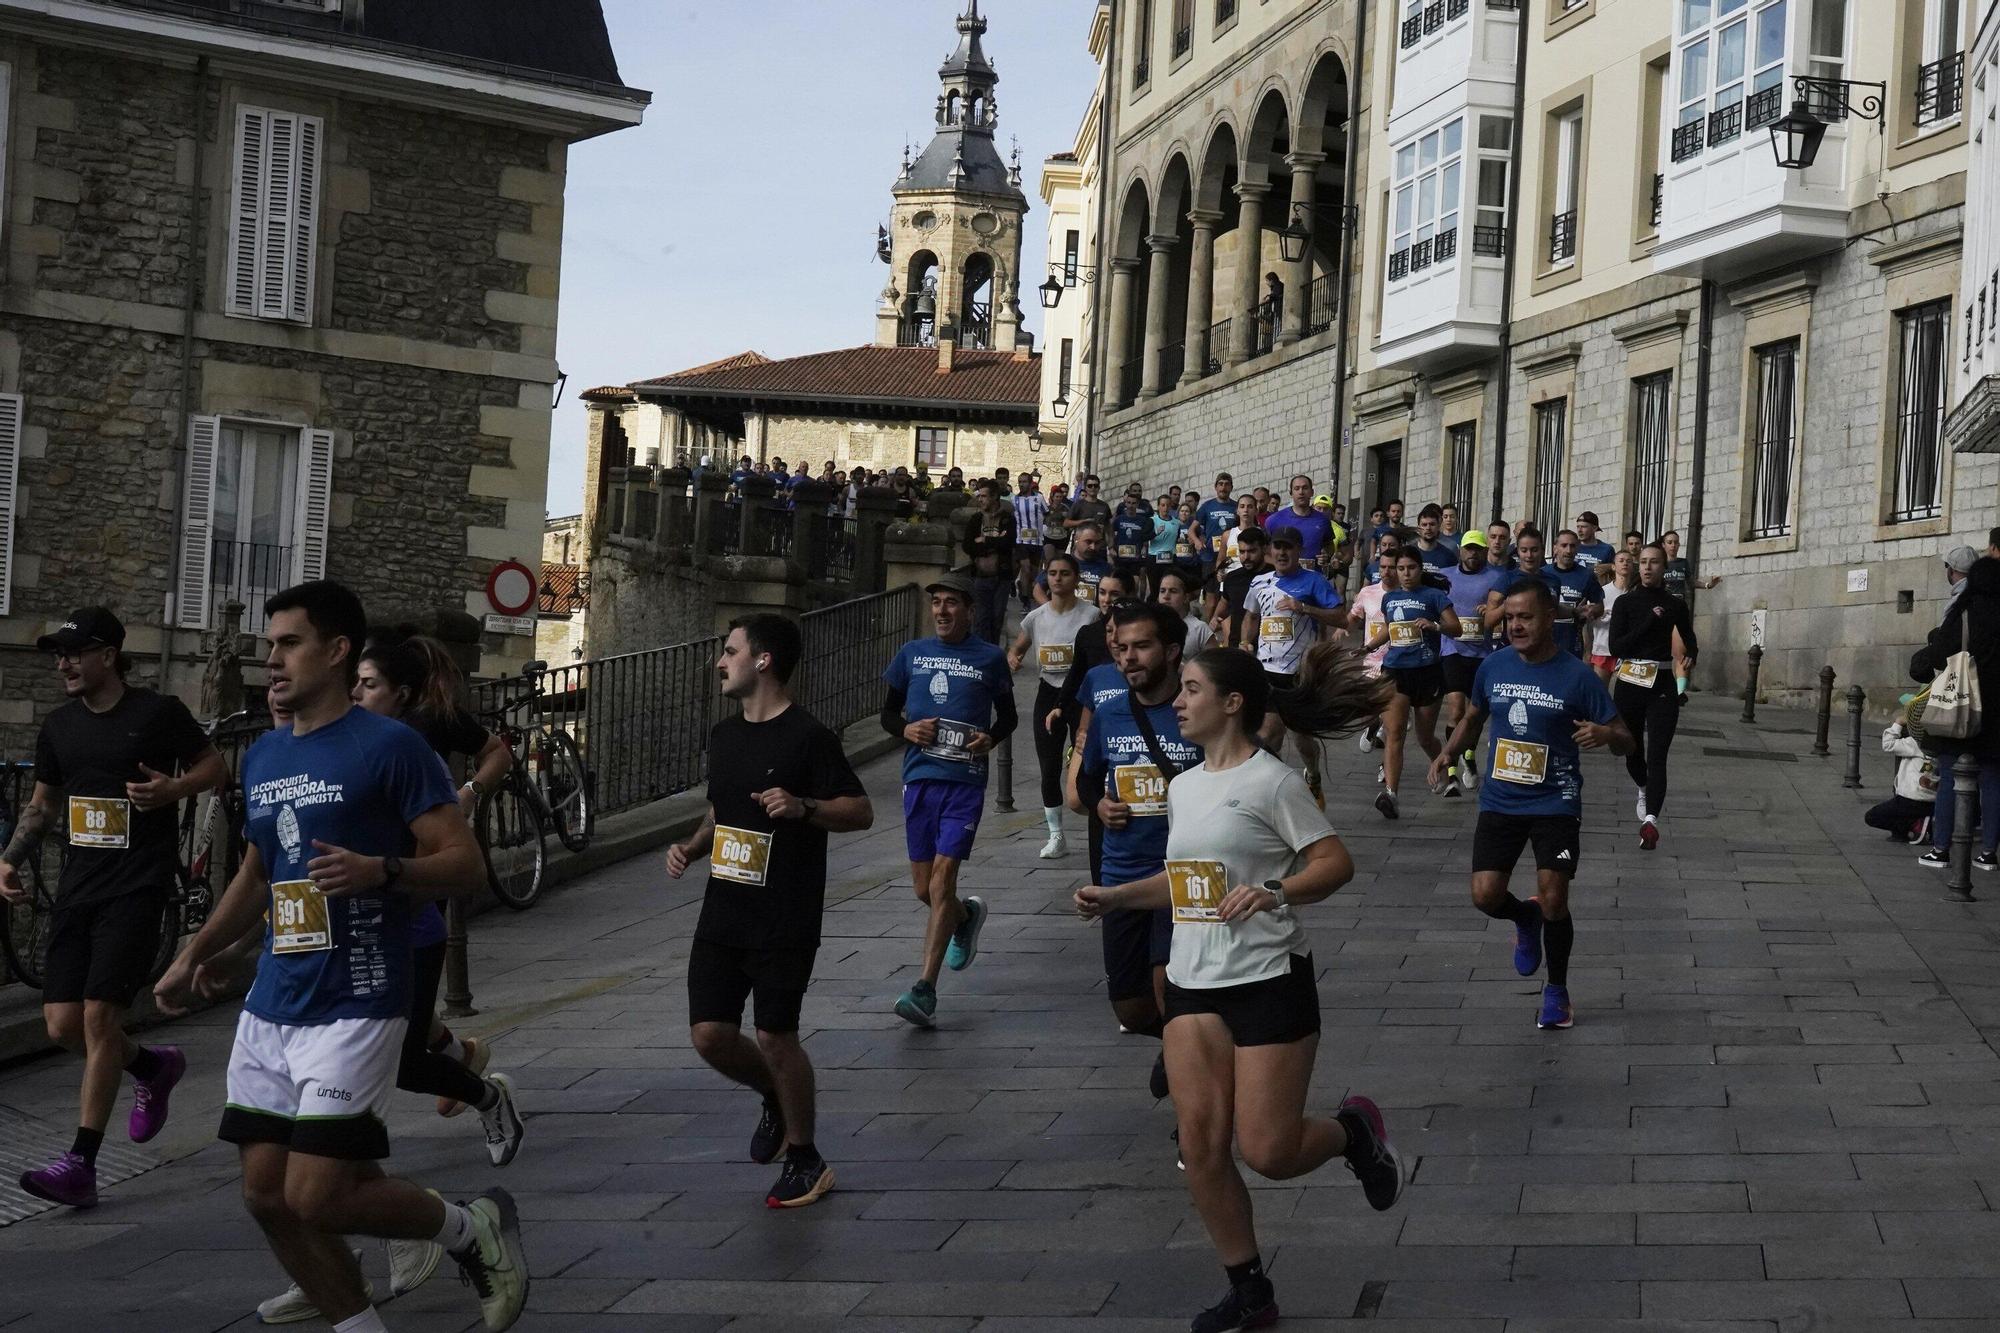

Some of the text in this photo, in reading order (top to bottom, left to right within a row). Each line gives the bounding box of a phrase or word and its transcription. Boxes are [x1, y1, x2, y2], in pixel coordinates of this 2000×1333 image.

[1397, 627, 1412, 637] 341
[922, 662, 974, 672] ALMENDRA
[948, 670, 982, 680] KONKISTA
[1500, 689, 1554, 702] ALMENDRA
[1501, 683, 1540, 692] CONQUISTA
[1527, 699, 1564, 710] KONKISTA
[937, 728, 964, 746] 890
[1118, 742, 1184, 753] ALMEDRA
[1506, 750, 1532, 768] 682
[251, 773, 309, 795] LA CONQUISTA
[1134, 777, 1165, 797] 514
[260, 780, 326, 806] ALMENDRA
[295, 792, 344, 809] KONKISTA
[86, 810, 106, 828] 88
[721, 840, 752, 864] 606
[1186, 876, 1210, 900] 161
[278, 898, 304, 926] 591
[318, 1087, 352, 1101] unbts
